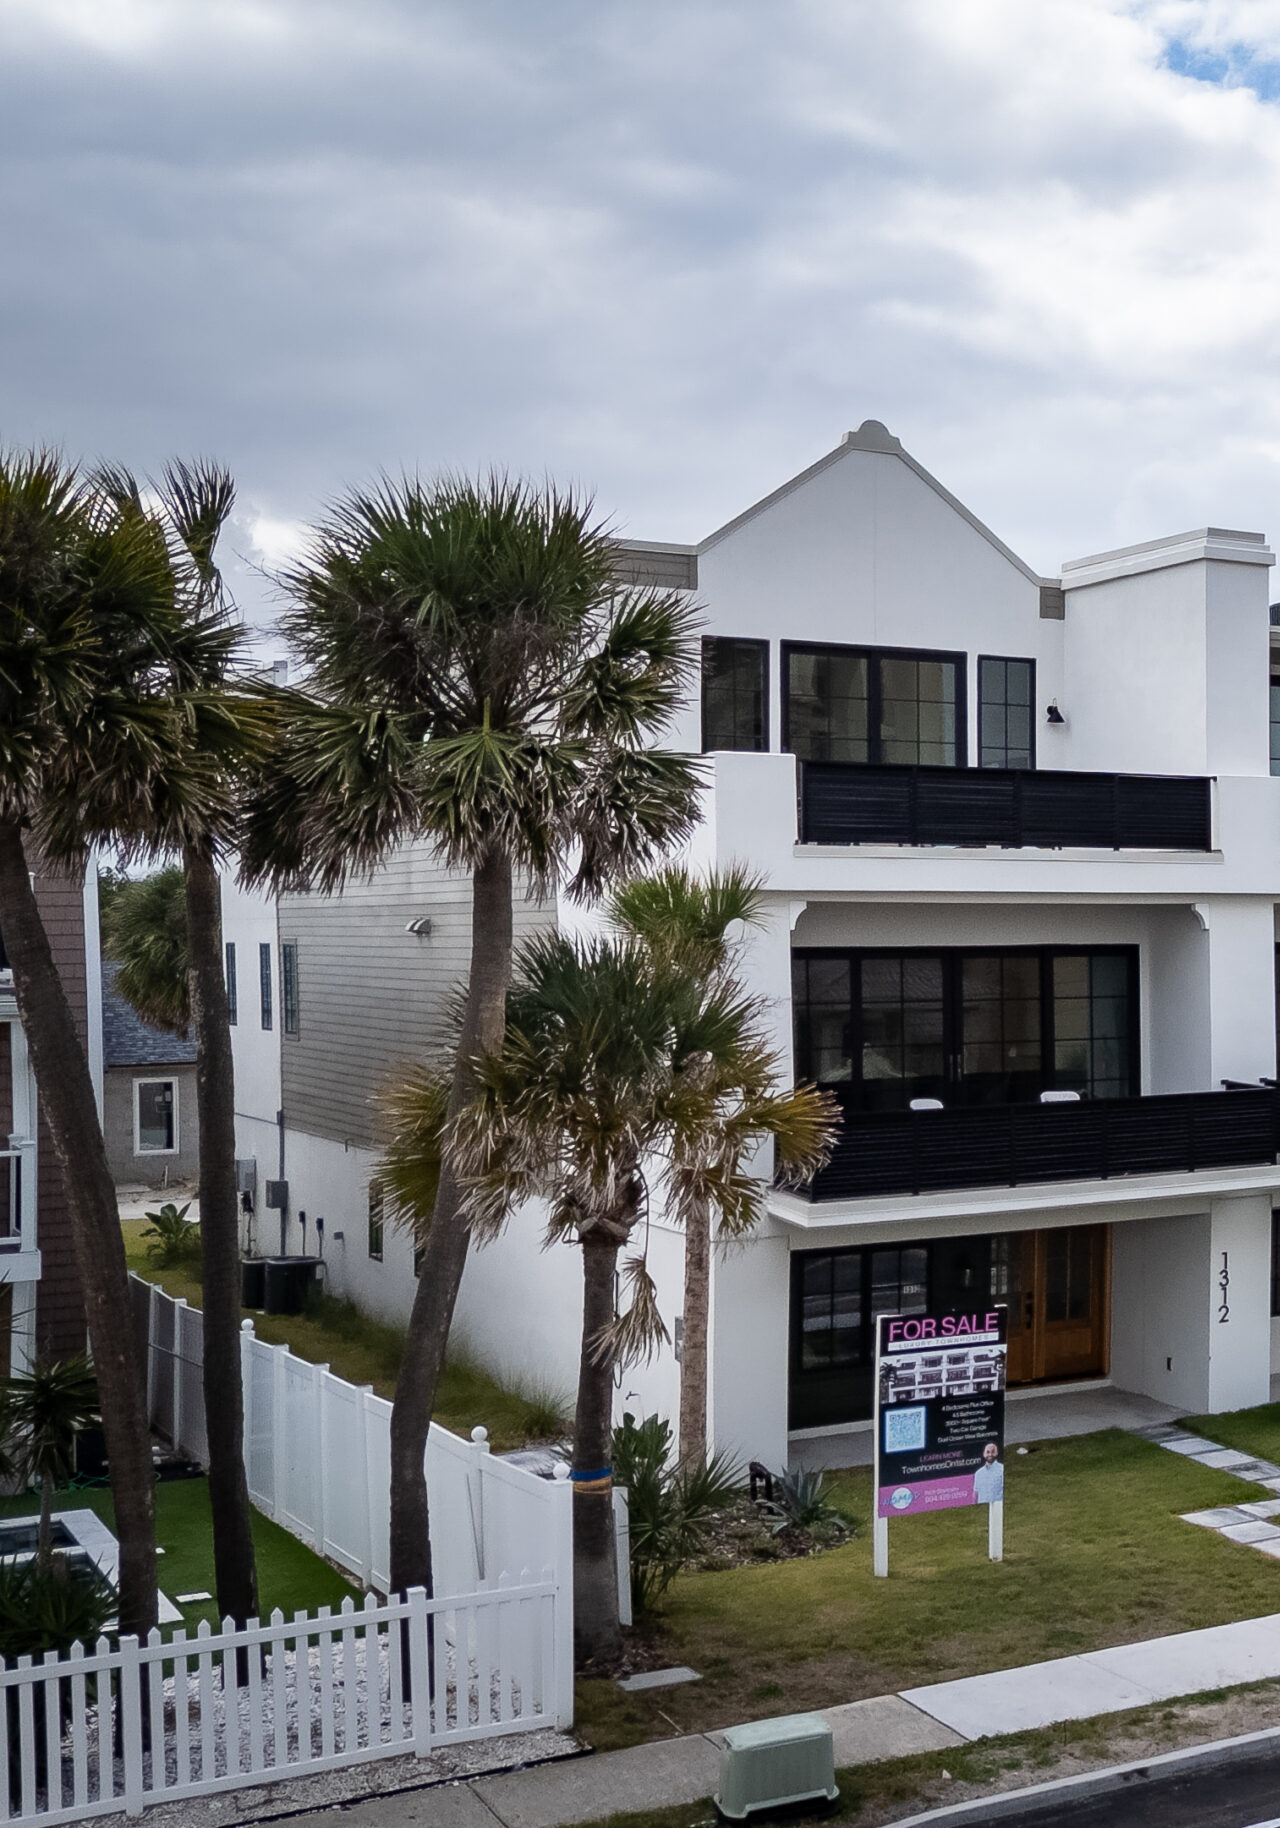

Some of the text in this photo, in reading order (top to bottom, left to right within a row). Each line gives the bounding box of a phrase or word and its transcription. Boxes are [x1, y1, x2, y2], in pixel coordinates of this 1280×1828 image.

[1218, 1251, 1230, 1324] 1312
[889, 1312, 999, 1341] FOR SALE
[898, 1334, 989, 1349] LUXURY TOWNHOMES
